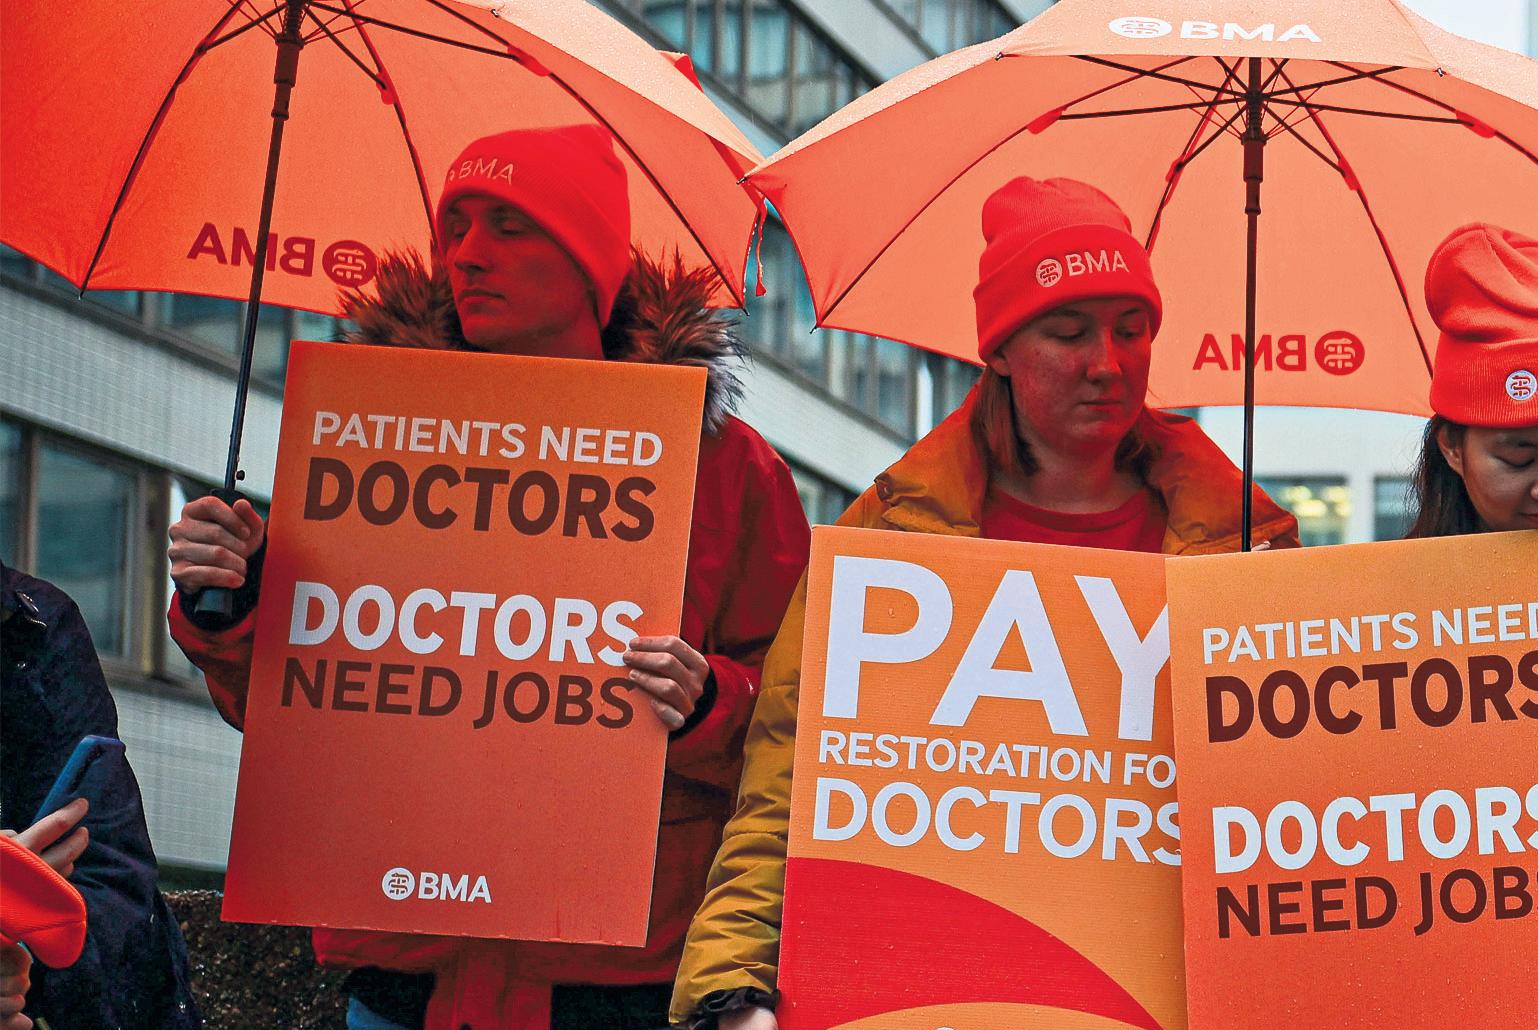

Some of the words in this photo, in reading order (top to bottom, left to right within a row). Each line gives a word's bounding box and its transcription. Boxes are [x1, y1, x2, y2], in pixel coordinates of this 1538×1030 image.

[1180, 20, 1322, 43] BMA
[459, 157, 514, 185] BMA
[1066, 249, 1131, 276] BMA
[312, 410, 526, 459] PATIENTS
[538, 425, 664, 467] NEED
[303, 456, 657, 542] DOCTORS
[288, 580, 644, 667] DOCTORS
[822, 554, 1172, 742] PAY
[1202, 611, 1420, 665] PATIENTS
[281, 656, 463, 717] NEED
[473, 670, 638, 730] JOBS
[818, 730, 1112, 785] RESTORATION
[1123, 751, 1177, 789] FO
[812, 776, 1182, 867] DOCTORS
[417, 870, 493, 904] BMA
[1215, 874, 1399, 940] NEED
